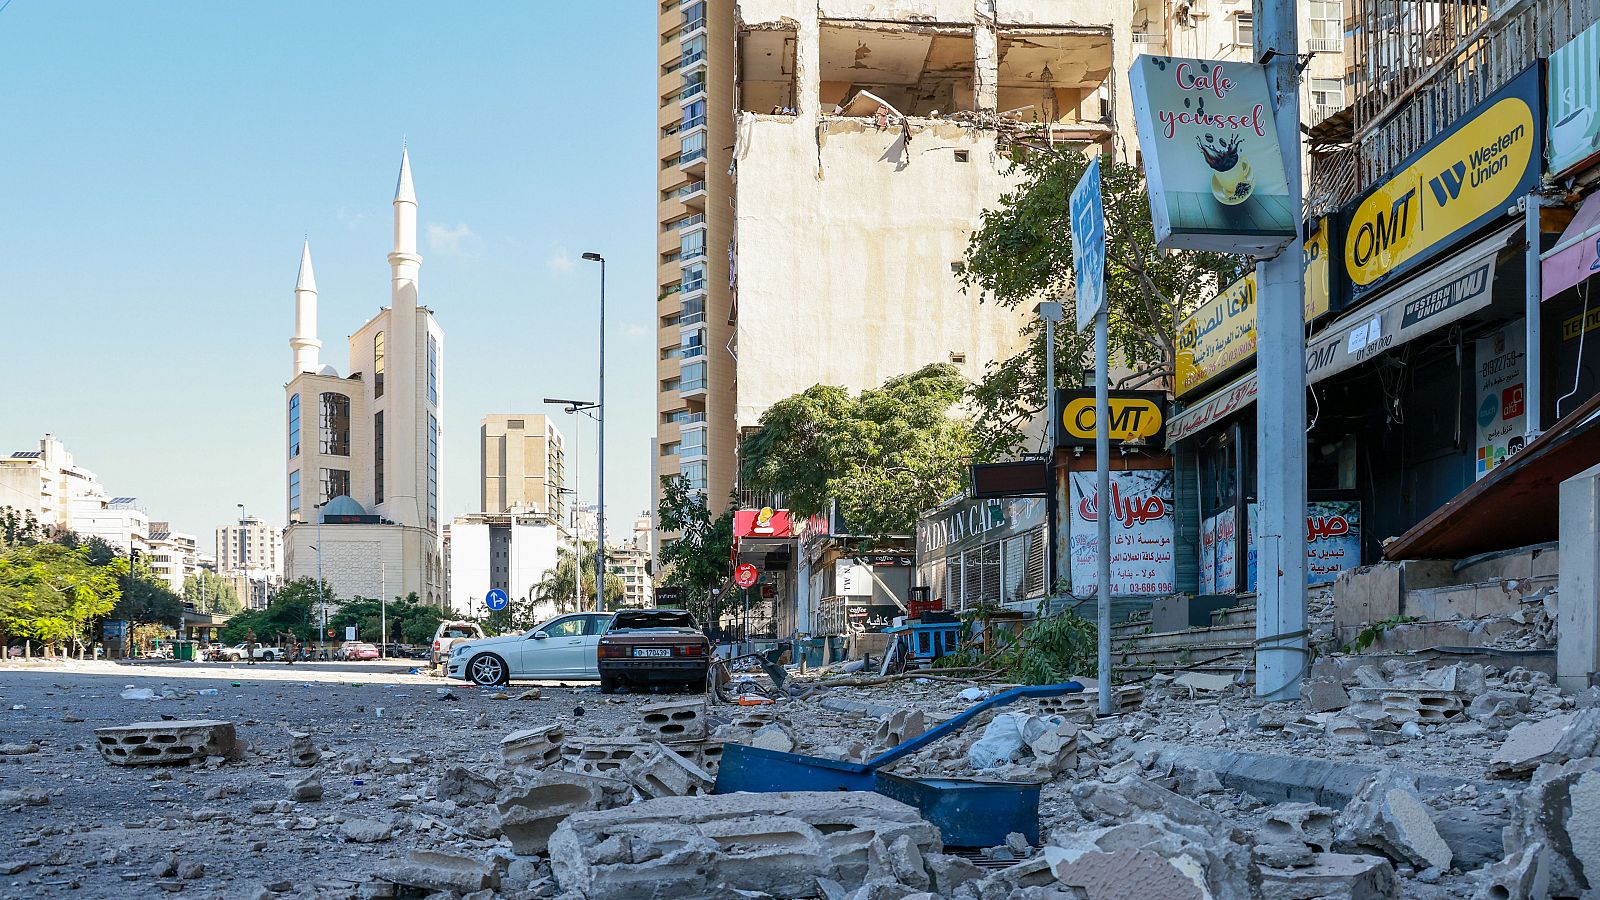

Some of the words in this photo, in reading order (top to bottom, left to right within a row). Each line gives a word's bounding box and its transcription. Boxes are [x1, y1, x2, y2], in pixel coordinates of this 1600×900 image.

[1175, 62, 1237, 99] Cafe
[1158, 103, 1266, 139] youssef
[1468, 123, 1524, 170] Western
[1470, 154, 1508, 188] Union
[1354, 187, 1416, 267] OMT
[1455, 269, 1484, 303] WU
[1405, 285, 1451, 316] WESTERN
[1417, 297, 1450, 320] UNION
[1305, 339, 1342, 374] OMT
[1075, 405, 1149, 432] OMT
[1503, 403, 1517, 416] alfa
[1509, 443, 1523, 455] iOS
[924, 510, 965, 553] ADNAN
[1122, 553, 1142, 561] العملات
[1143, 552, 1155, 561] كافة
[1155, 552, 1171, 563] تبديل
[1317, 548, 1345, 560] تبديل
[1117, 568, 1134, 581] بناية
[1141, 569, 1156, 579] كولا
[1311, 562, 1342, 576] العربية
[1129, 583, 1156, 593] 03-686
[1157, 582, 1172, 593] 996
